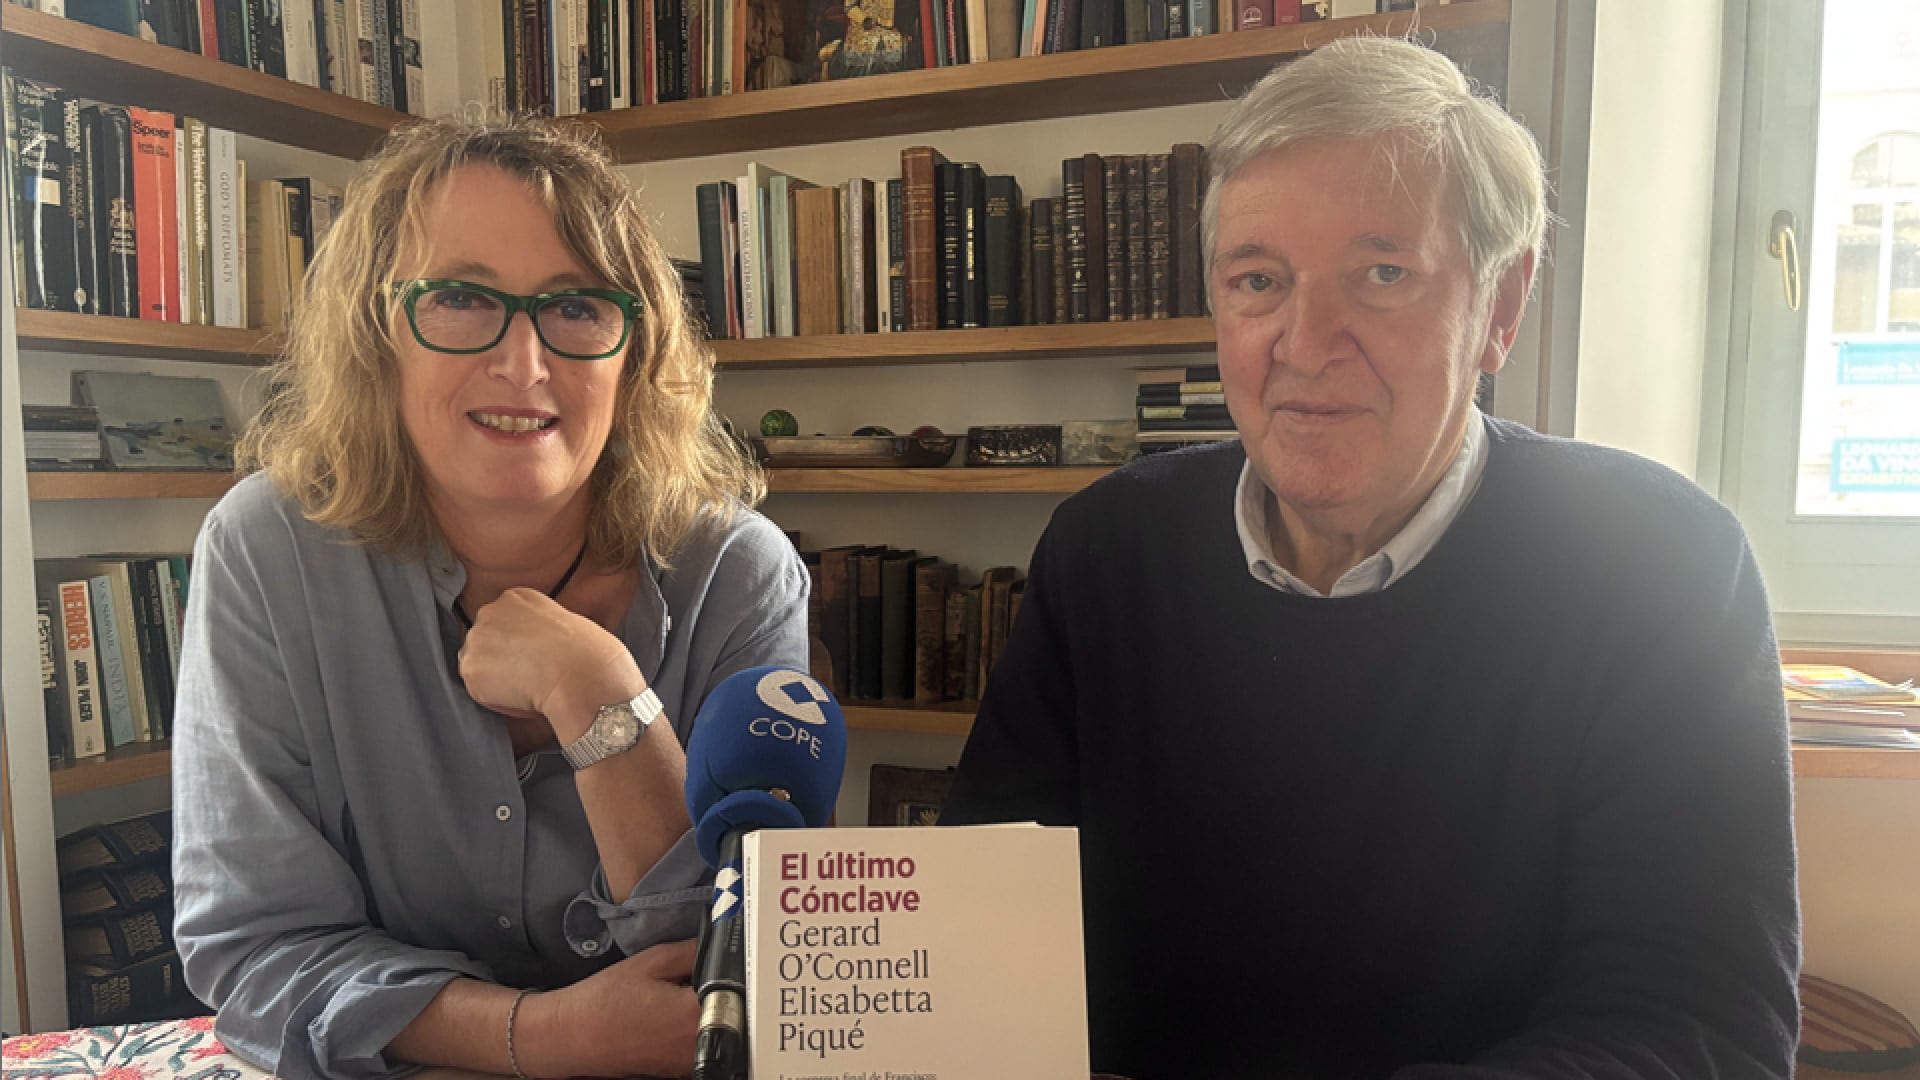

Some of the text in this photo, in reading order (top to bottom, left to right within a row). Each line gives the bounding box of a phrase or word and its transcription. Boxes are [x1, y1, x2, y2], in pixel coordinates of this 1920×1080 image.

[133, 119, 171, 138] Speer
[219, 171, 230, 210] GOD'S
[222, 213, 234, 284] DIPLOMATS
[62, 585, 91, 651] HEROES
[107, 656, 126, 716] INDIA
[748, 717, 822, 761] COPE
[781, 851, 916, 881] El último
[779, 883, 921, 915] Cónclave
[779, 916, 881, 949] Gerard
[779, 949, 930, 983] O'Connell
[779, 984, 933, 1017] Elisabetta
[778, 1018, 865, 1060] Piqué
